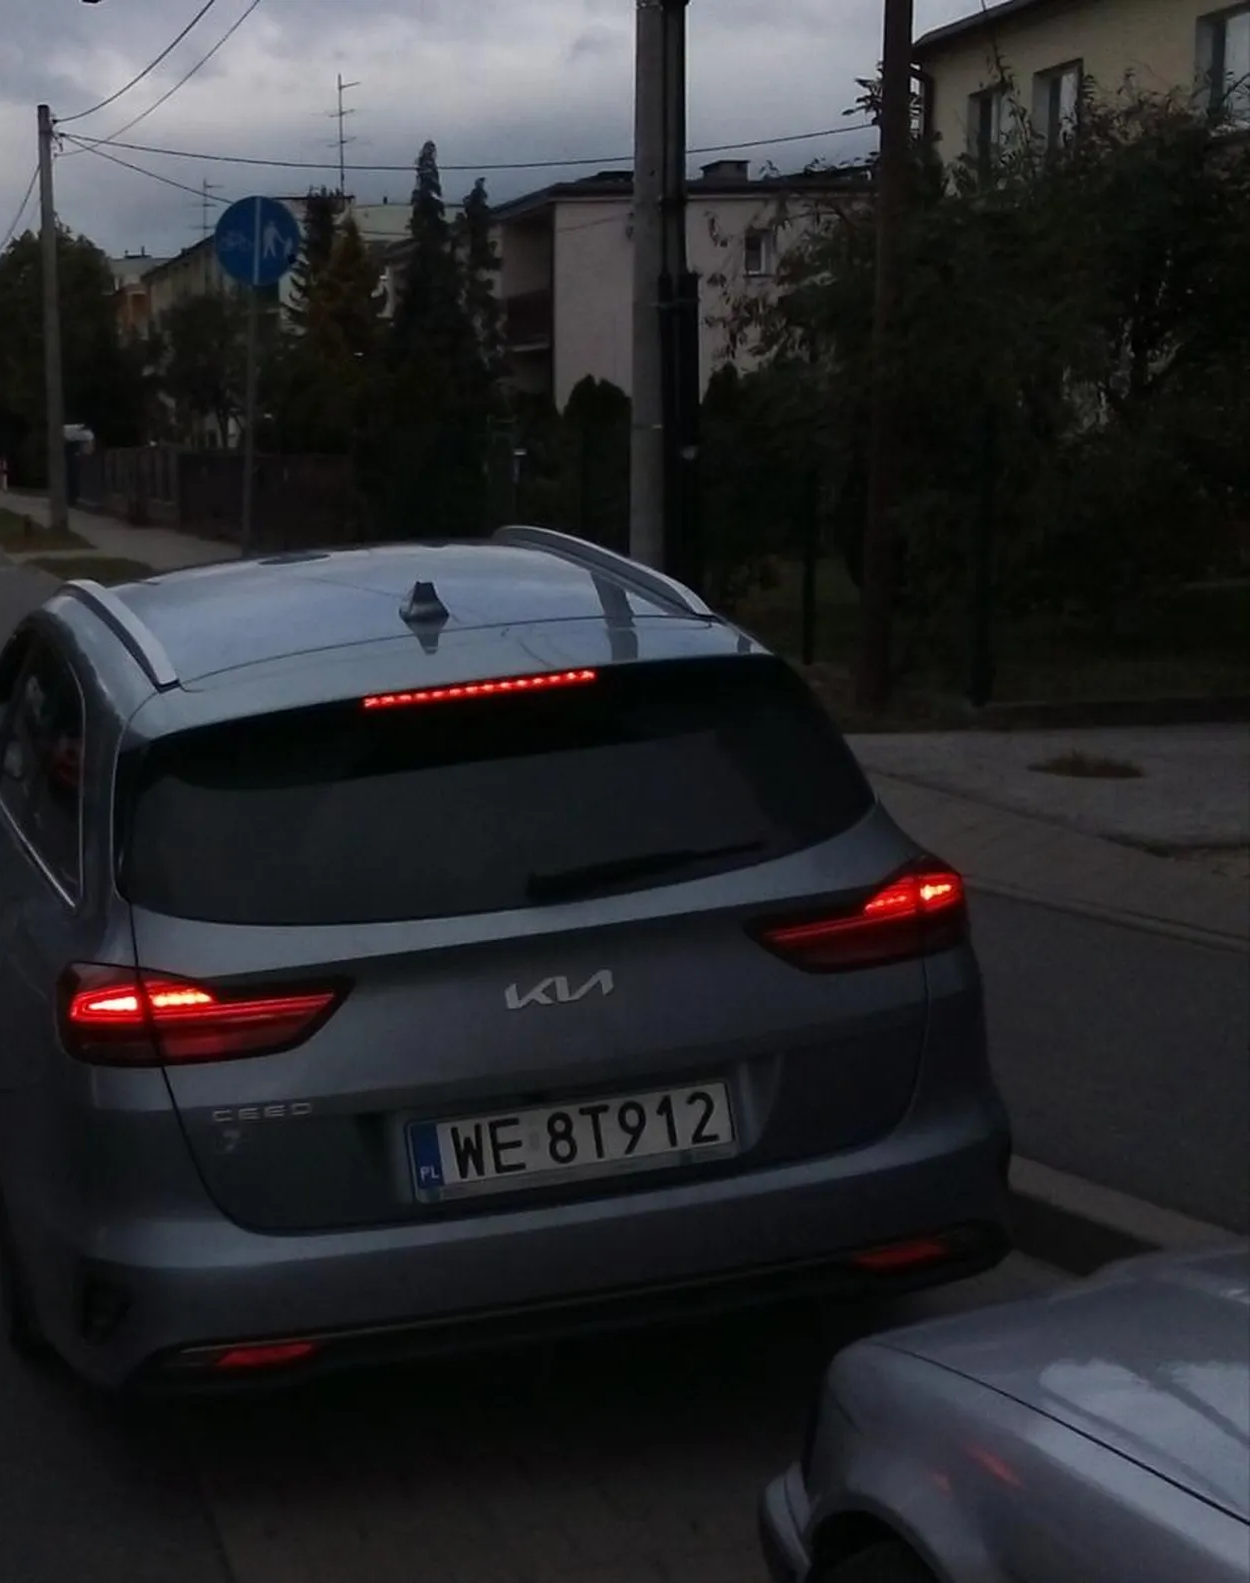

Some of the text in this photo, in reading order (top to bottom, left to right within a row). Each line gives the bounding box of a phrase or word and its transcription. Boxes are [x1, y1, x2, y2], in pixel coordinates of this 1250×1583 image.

[505, 969, 614, 1009] KIA
[213, 1102, 312, 1122] CEED
[451, 1091, 719, 1179] WE 8T912
[420, 1165, 440, 1182] PL
